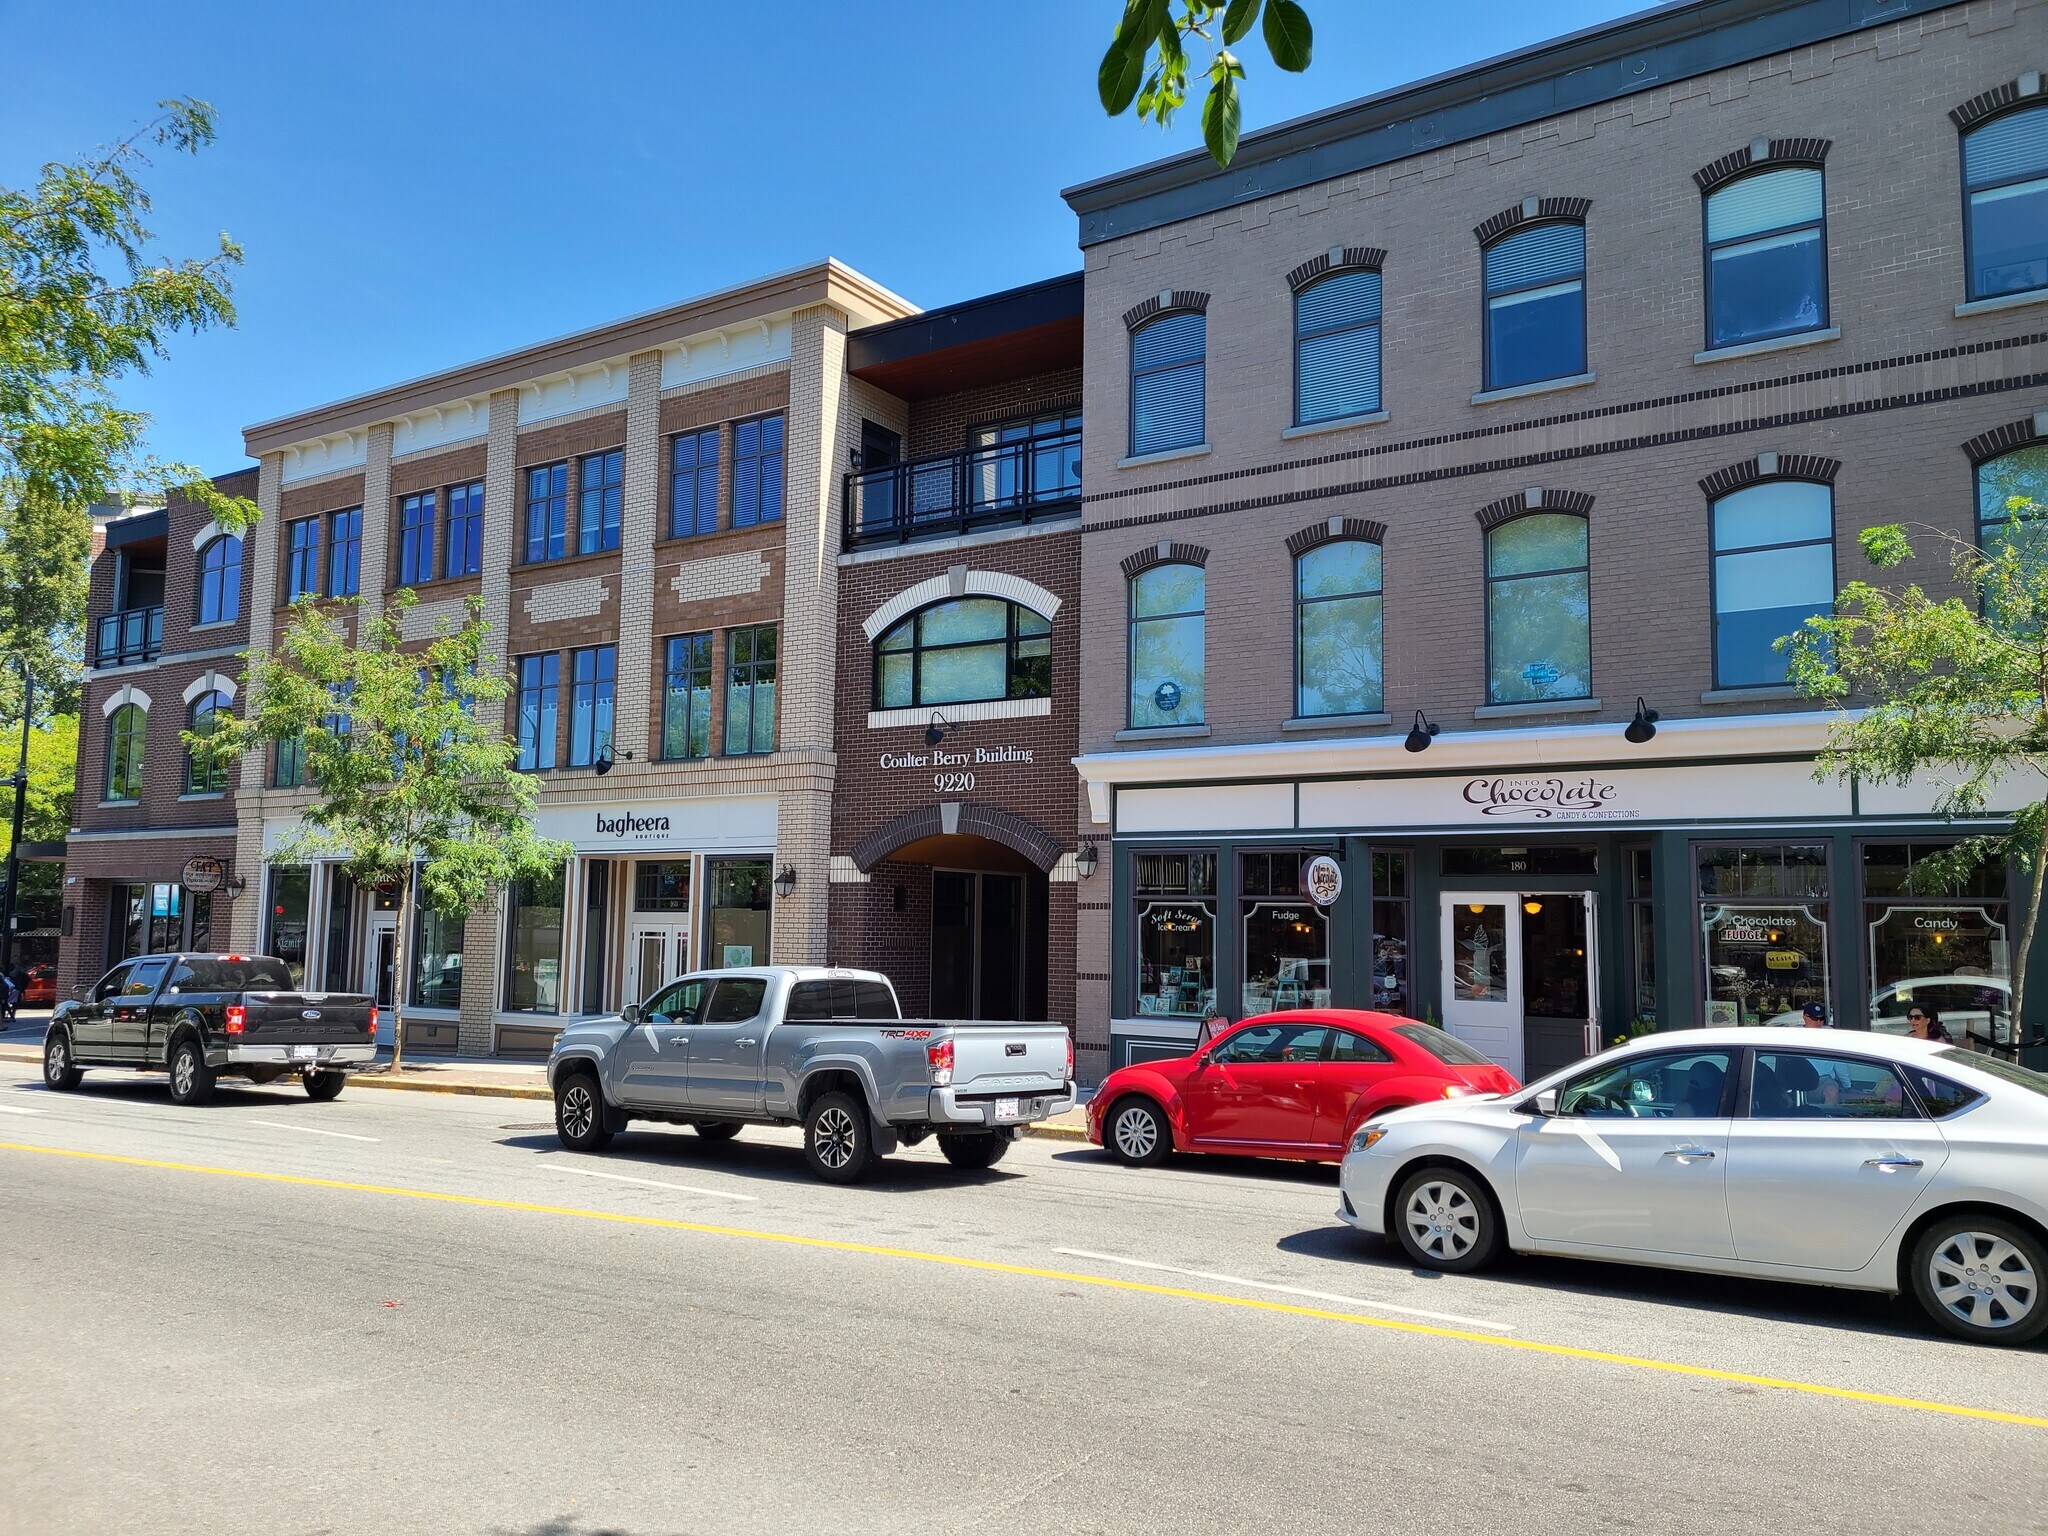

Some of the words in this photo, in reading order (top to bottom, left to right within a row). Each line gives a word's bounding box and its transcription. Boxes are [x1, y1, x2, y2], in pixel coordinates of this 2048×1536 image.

[880, 753, 928, 769] Coulter
[933, 750, 970, 767] Berry
[975, 746, 1034, 764] Building
[934, 772, 975, 793] 9220
[1510, 779, 1540, 787] INTO
[1462, 778, 1618, 808] Chocolate
[1556, 811, 1577, 820] CANDY
[1582, 811, 1588, 819] &
[1593, 809, 1641, 819] CONFECTIONS
[596, 811, 670, 838] bagheera
[1510, 861, 1527, 871] 180
[1151, 909, 1172, 925] Soft
[1174, 909, 1203, 925] Serve
[1272, 910, 1300, 921] Fudge
[1732, 915, 1797, 926] Chocolates
[1157, 922, 1168, 932] Ice
[1170, 922, 1196, 932] Cream
[1914, 917, 1958, 930] Candy
[1727, 930, 1762, 940] FUDGE
[880, 1030, 906, 1039] TRD
[979, 1076, 1045, 1087] TACOMA
